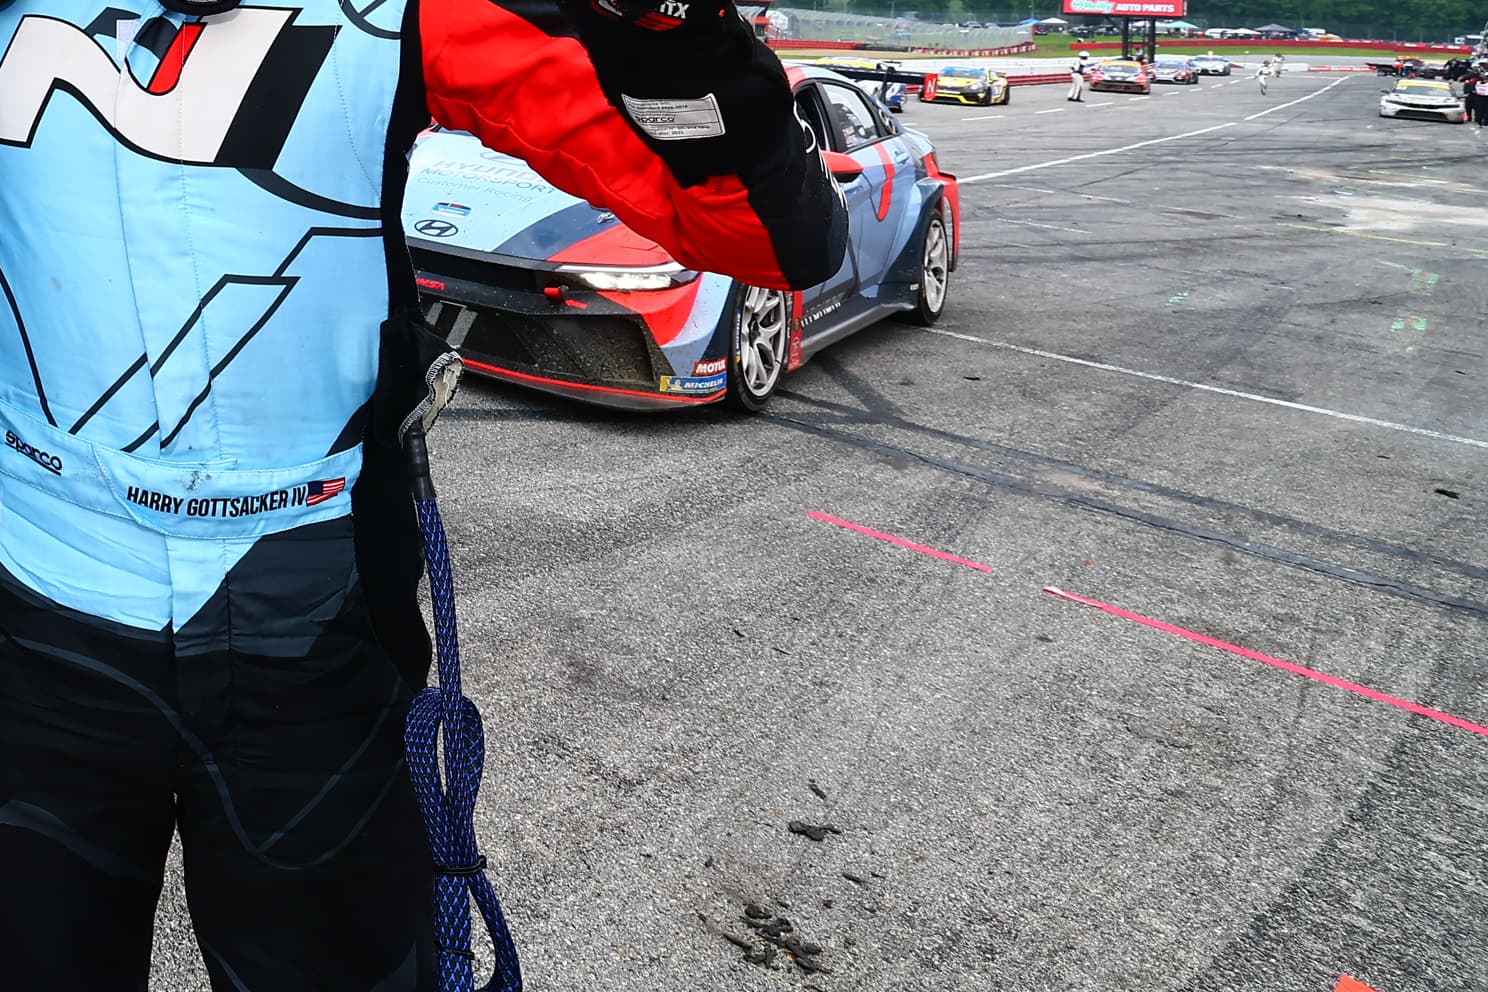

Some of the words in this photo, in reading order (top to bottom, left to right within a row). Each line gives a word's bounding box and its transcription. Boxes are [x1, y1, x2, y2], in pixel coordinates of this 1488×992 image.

[1116, 2, 1141, 12] AUTO
[1142, 3, 1175, 13] PARTS
[434, 160, 543, 182] HYUND
[416, 177, 484, 193] Customer
[485, 187, 534, 203] Racing
[695, 358, 726, 374] MOTUL
[684, 378, 724, 389] MICHELIN
[4, 430, 64, 476] sparco
[126, 486, 184, 516] HARRY
[186, 489, 289, 519] GOTTSACKER
[291, 487, 307, 507] IV
